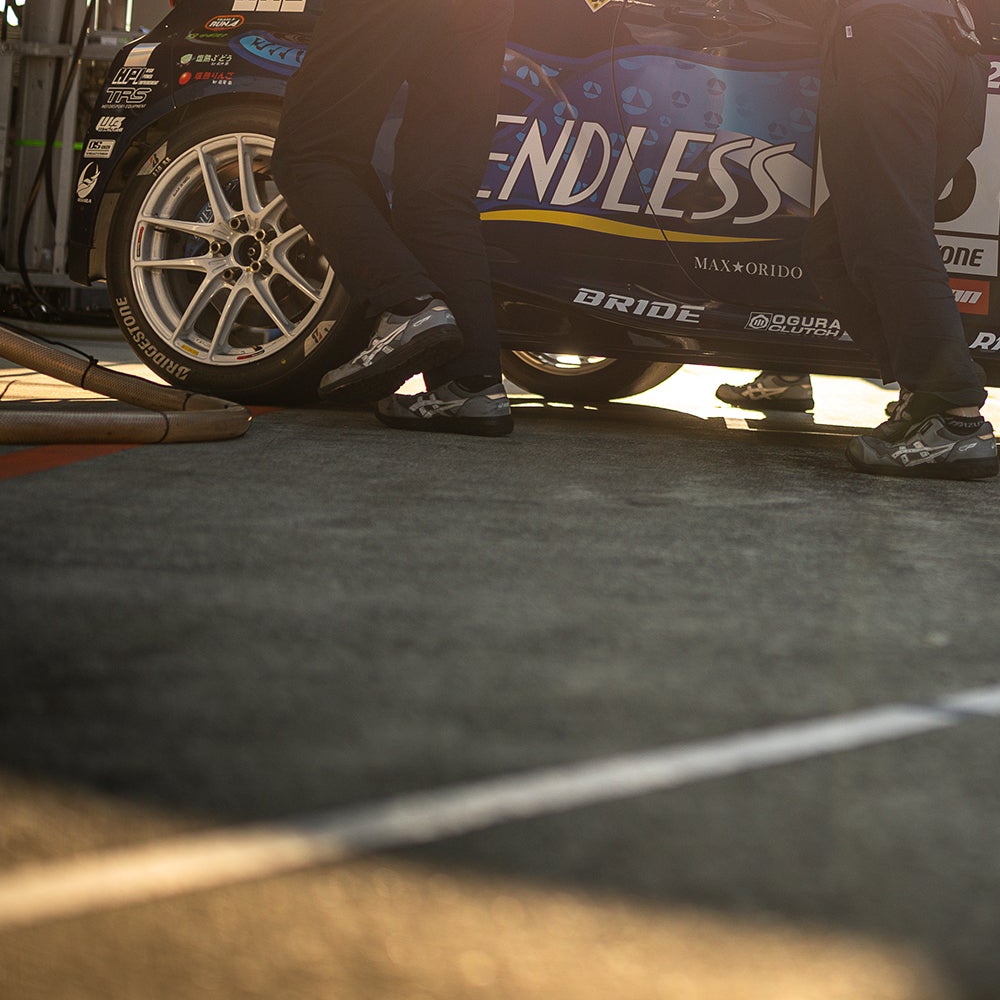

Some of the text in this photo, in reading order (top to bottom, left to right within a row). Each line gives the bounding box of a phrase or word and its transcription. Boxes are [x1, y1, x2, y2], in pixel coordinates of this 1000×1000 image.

[107, 87, 152, 104] TRS
[573, 288, 705, 323] BRIDE
[772, 314, 840, 329] OGURA
[116, 297, 191, 380] BRIDGESTONE
[768, 325, 840, 337] CLUTCH
